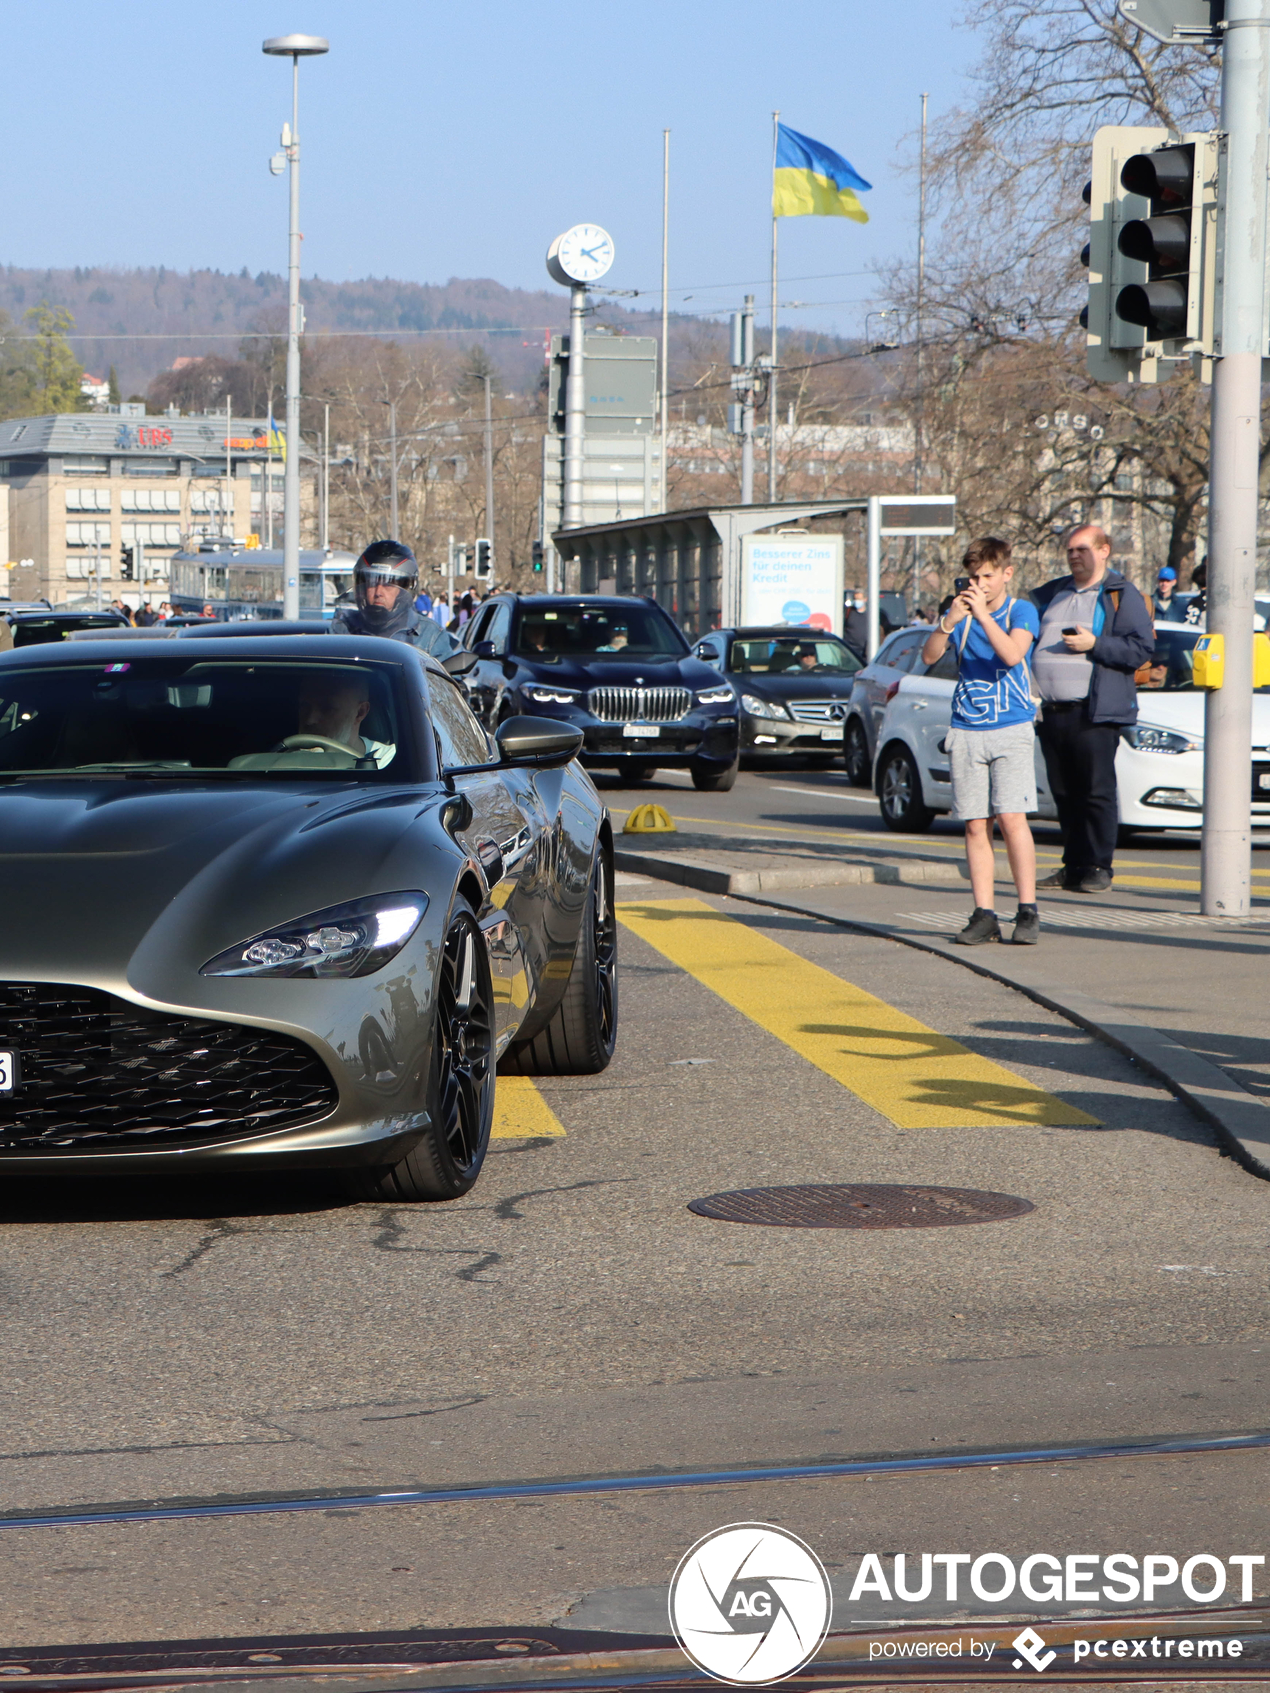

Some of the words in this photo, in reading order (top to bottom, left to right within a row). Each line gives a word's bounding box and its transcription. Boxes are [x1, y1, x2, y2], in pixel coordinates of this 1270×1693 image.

[1023, 410, 1105, 440] ORSO
[138, 428, 172, 446] UBS
[753, 548, 803, 559] Besserer
[807, 548, 832, 559] Zins
[752, 560, 770, 571] für
[773, 561, 812, 571] deinen
[752, 573, 788, 583] Kredit
